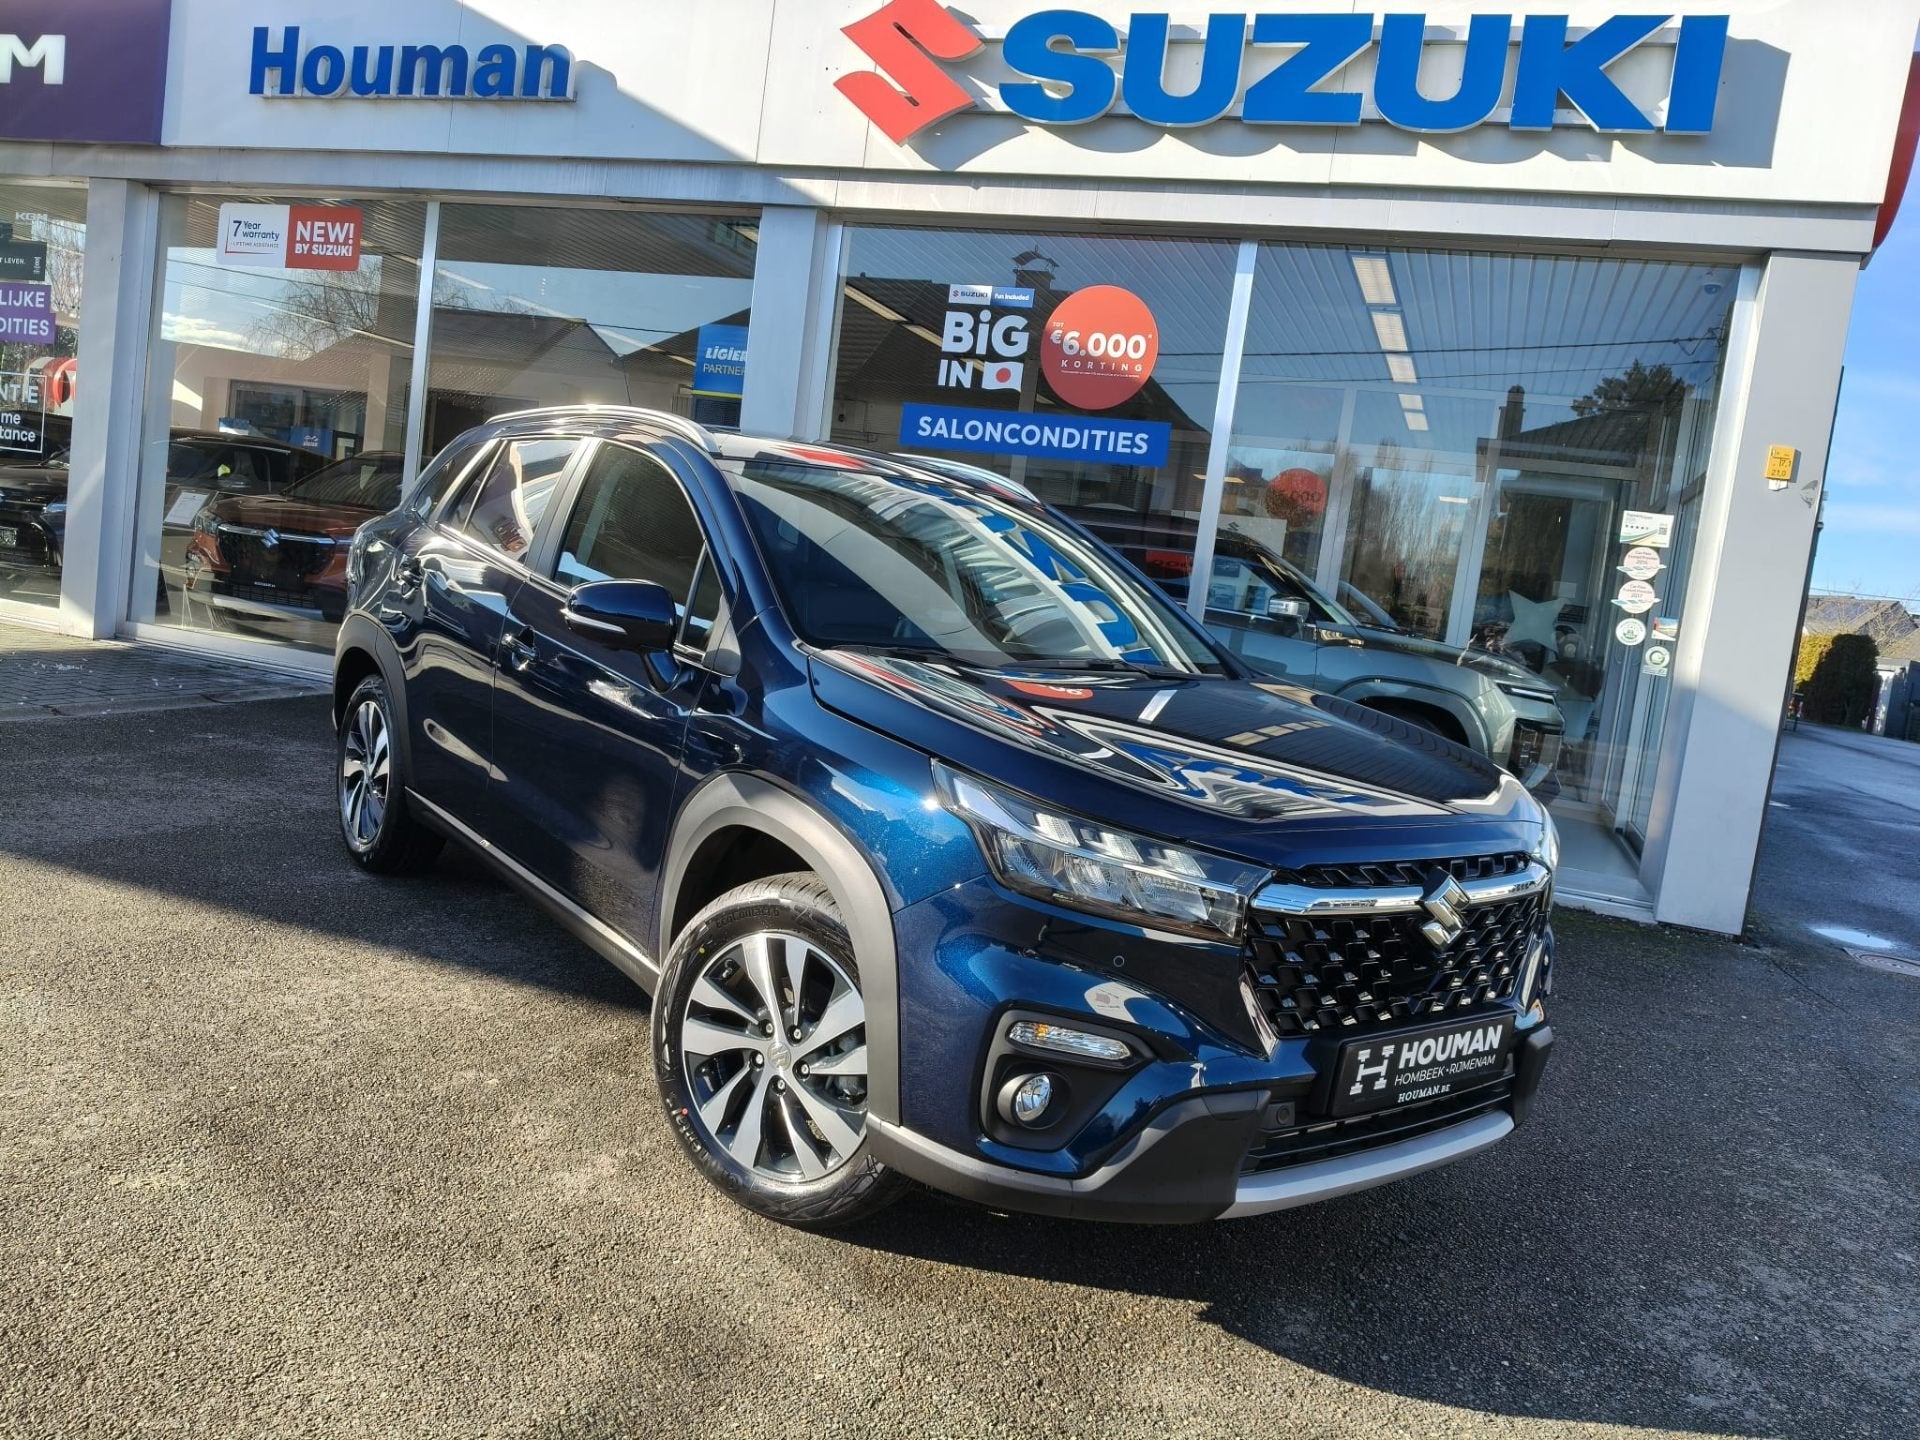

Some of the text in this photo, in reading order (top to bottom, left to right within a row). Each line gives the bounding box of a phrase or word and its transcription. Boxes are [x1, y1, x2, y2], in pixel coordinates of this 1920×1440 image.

[0, 34, 65, 84] M
[249, 26, 577, 100] Houman
[1000, 8, 1729, 136] SUZUKI
[232, 220, 261, 237] 7 Year
[242, 229, 280, 242] warranty
[296, 220, 355, 245] NEW!
[295, 243, 310, 254] BY
[0, 289, 45, 308] LIJKE
[960, 290, 988, 298] SUZUKI
[937, 359, 974, 389] IN
[1061, 359, 1143, 372] KORTING
[0, 426, 36, 443] tance
[917, 415, 1149, 455] SALONCONDITIES
[1398, 1024, 1503, 1069] HOUMAN
[1394, 1054, 1497, 1087] HOMBEEK RIJMENAM
[1397, 1083, 1451, 1103] HOUMAN.BE
